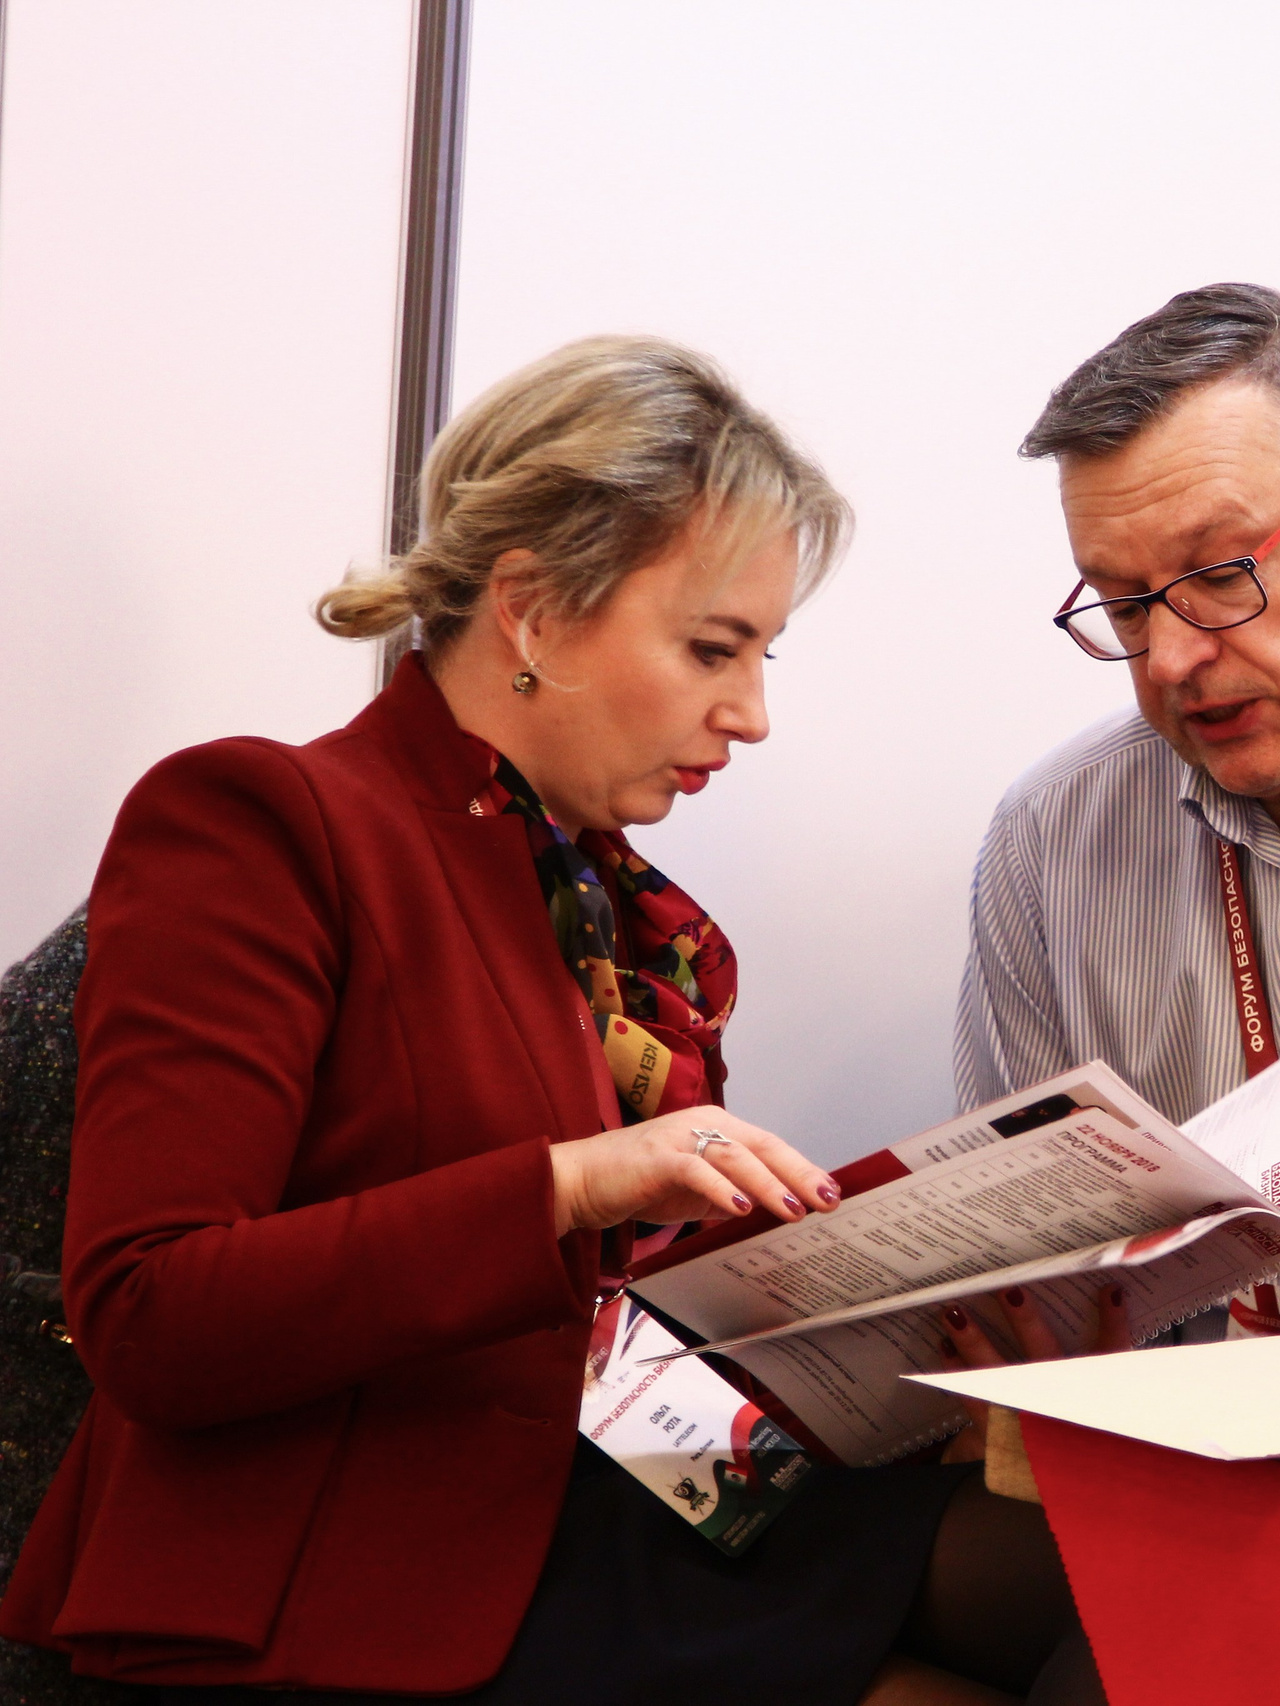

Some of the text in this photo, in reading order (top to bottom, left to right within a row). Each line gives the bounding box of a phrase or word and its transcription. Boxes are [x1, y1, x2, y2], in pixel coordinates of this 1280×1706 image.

[1240, 972, 1265, 1053] ФОРУМ
[1056, 1130, 1129, 1174] ПРОГРАММА
[590, 1417, 614, 1440] ФОРУМ
[611, 1373, 657, 1419] БЕЗОПАСНОСТЬ
[649, 1404, 672, 1425] ОЛЬГА
[662, 1416, 682, 1434] РОТА
[672, 1423, 698, 1447] LATTELECOM
